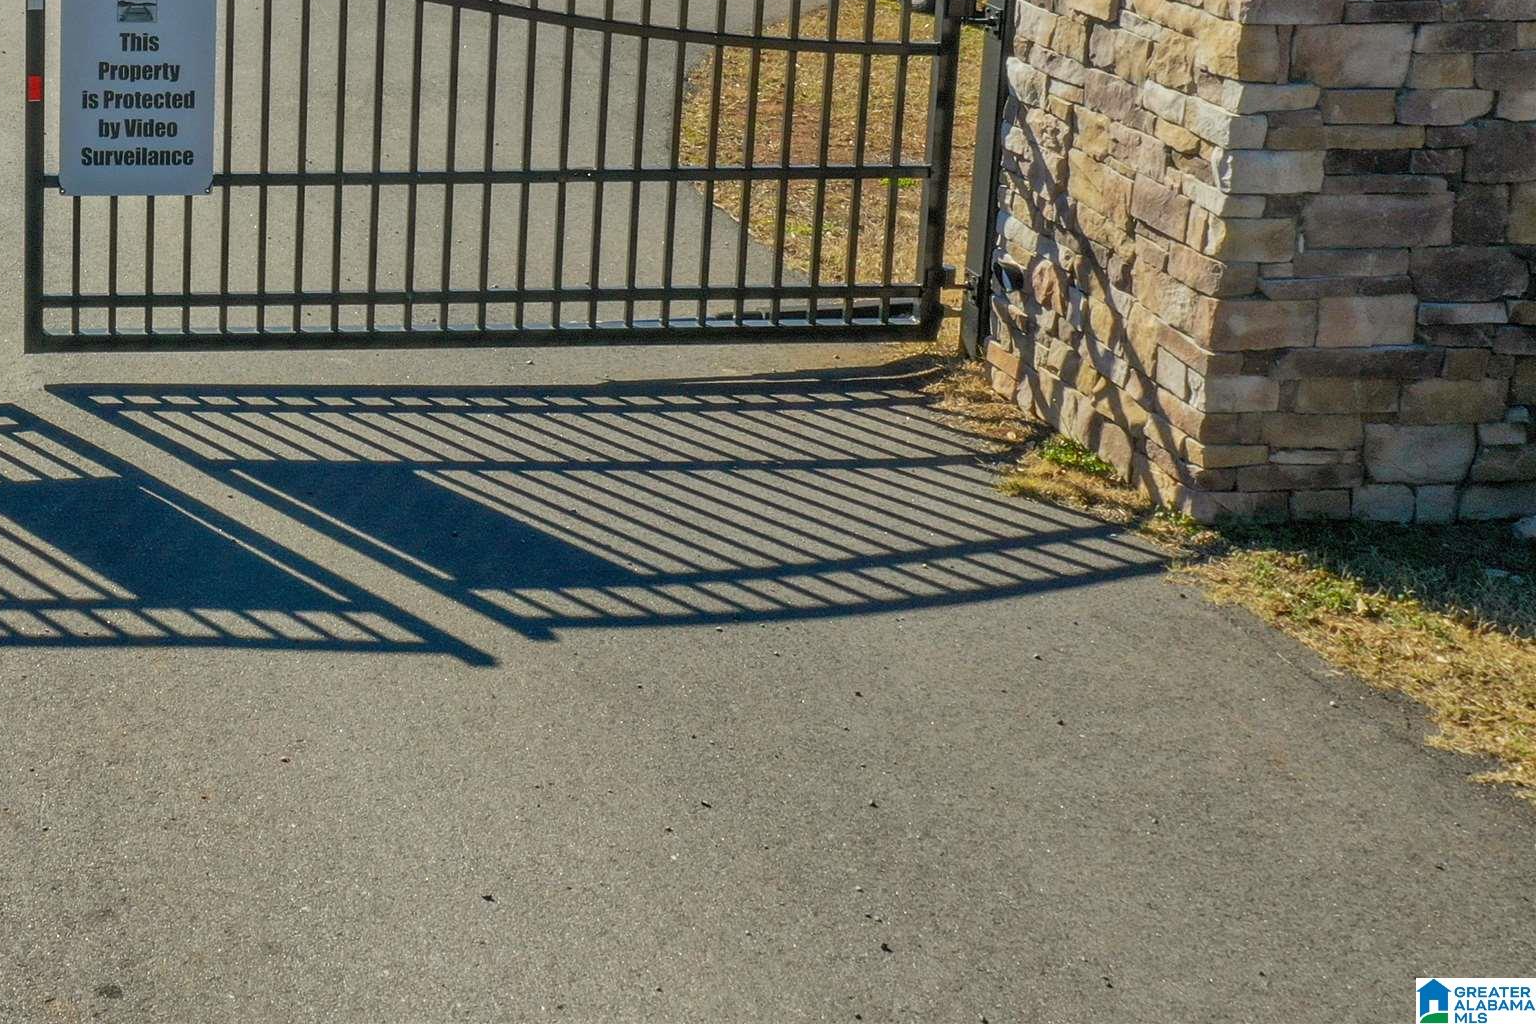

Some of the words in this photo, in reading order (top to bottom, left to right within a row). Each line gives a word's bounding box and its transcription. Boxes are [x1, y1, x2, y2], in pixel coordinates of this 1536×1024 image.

[120, 33, 160, 52] This
[98, 62, 180, 82] Property
[82, 90, 99, 109] is
[103, 90, 195, 109] Protected
[98, 119, 121, 139] by
[124, 119, 178, 137] Video
[81, 147, 194, 166] Surveilance
